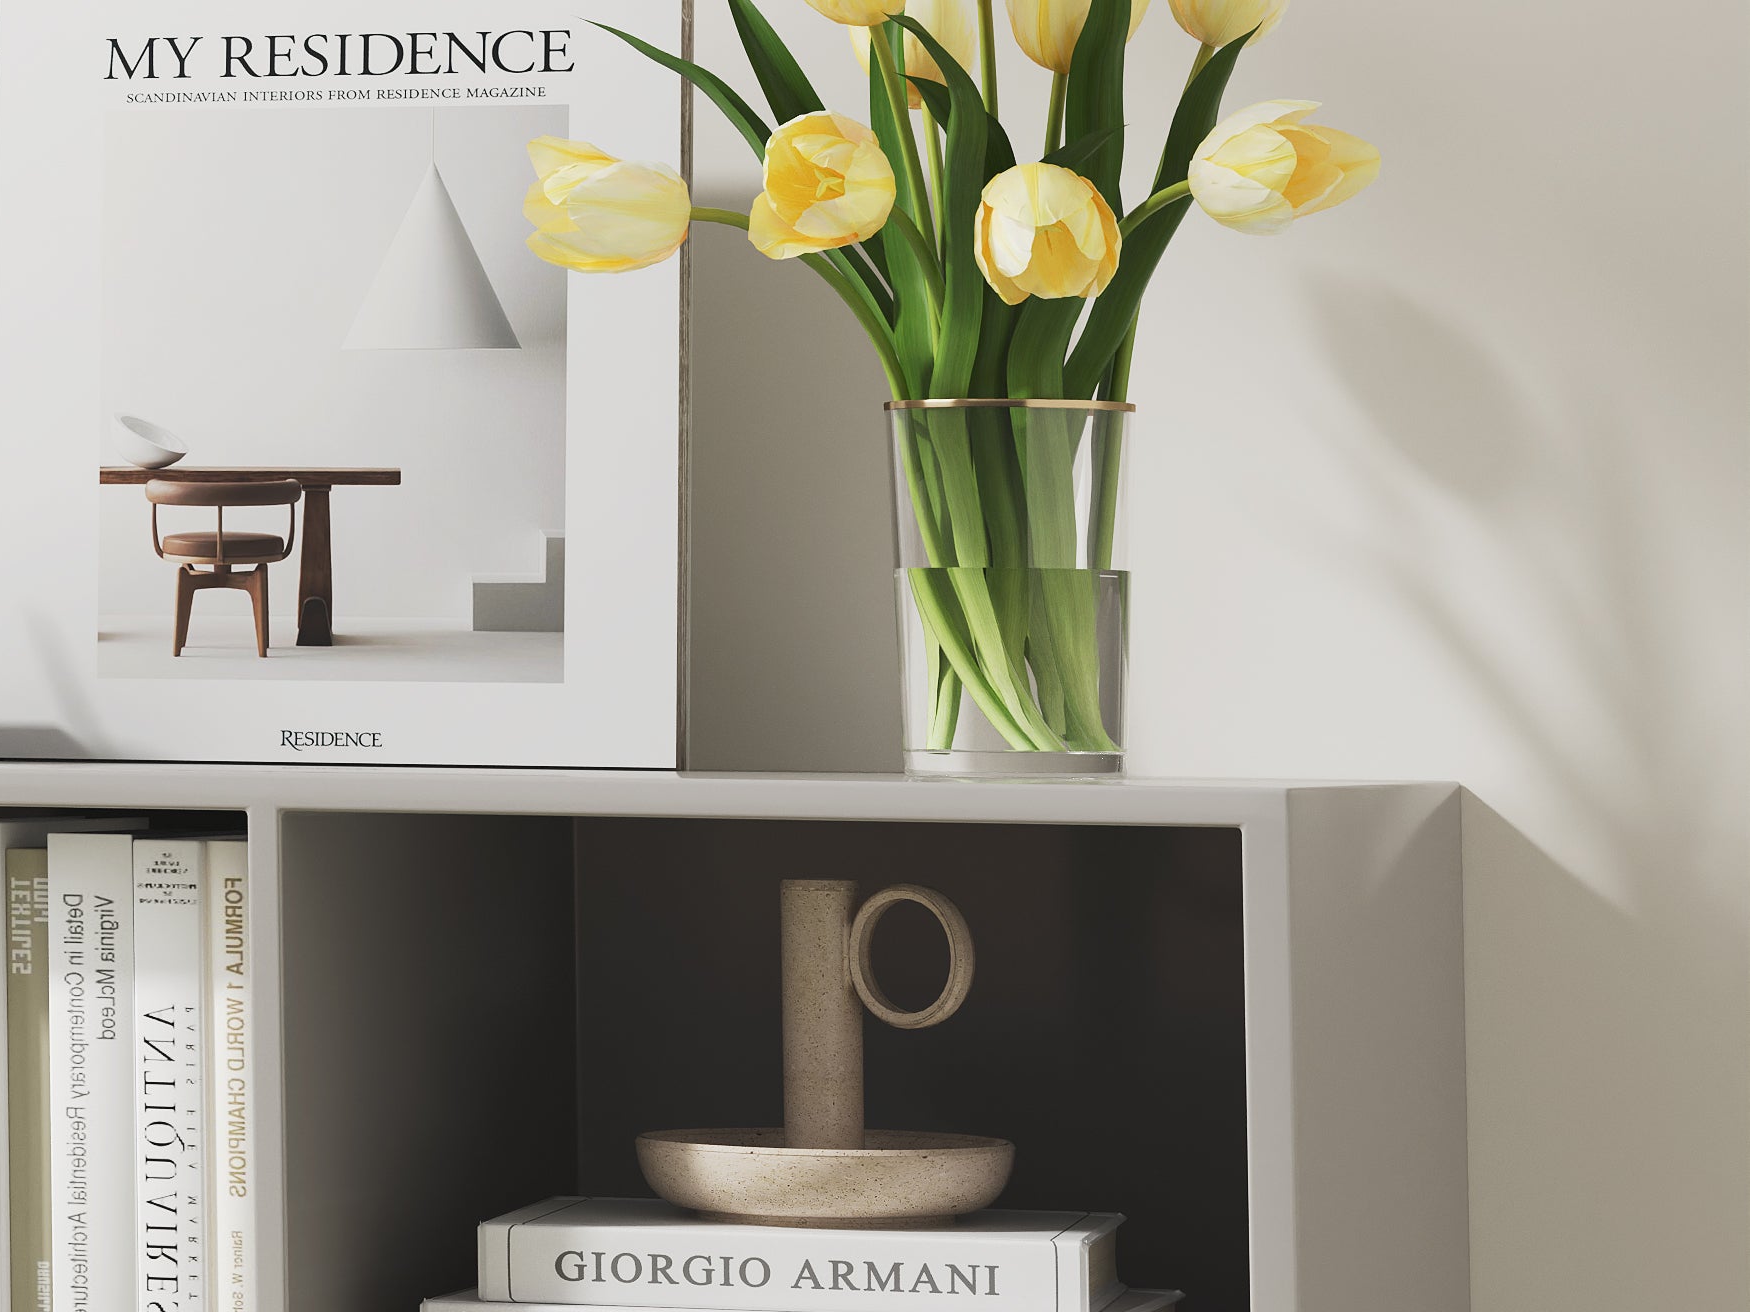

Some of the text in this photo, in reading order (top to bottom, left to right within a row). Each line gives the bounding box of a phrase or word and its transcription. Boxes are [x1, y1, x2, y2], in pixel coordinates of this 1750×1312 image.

[103, 29, 576, 81] MY RESIDENCE
[126, 86, 547, 104] SCANDINAVIAN INTERIORS FROM RESIDENCE MAGAZINE
[554, 1249, 1002, 1298] GIORGIO ARMANI
